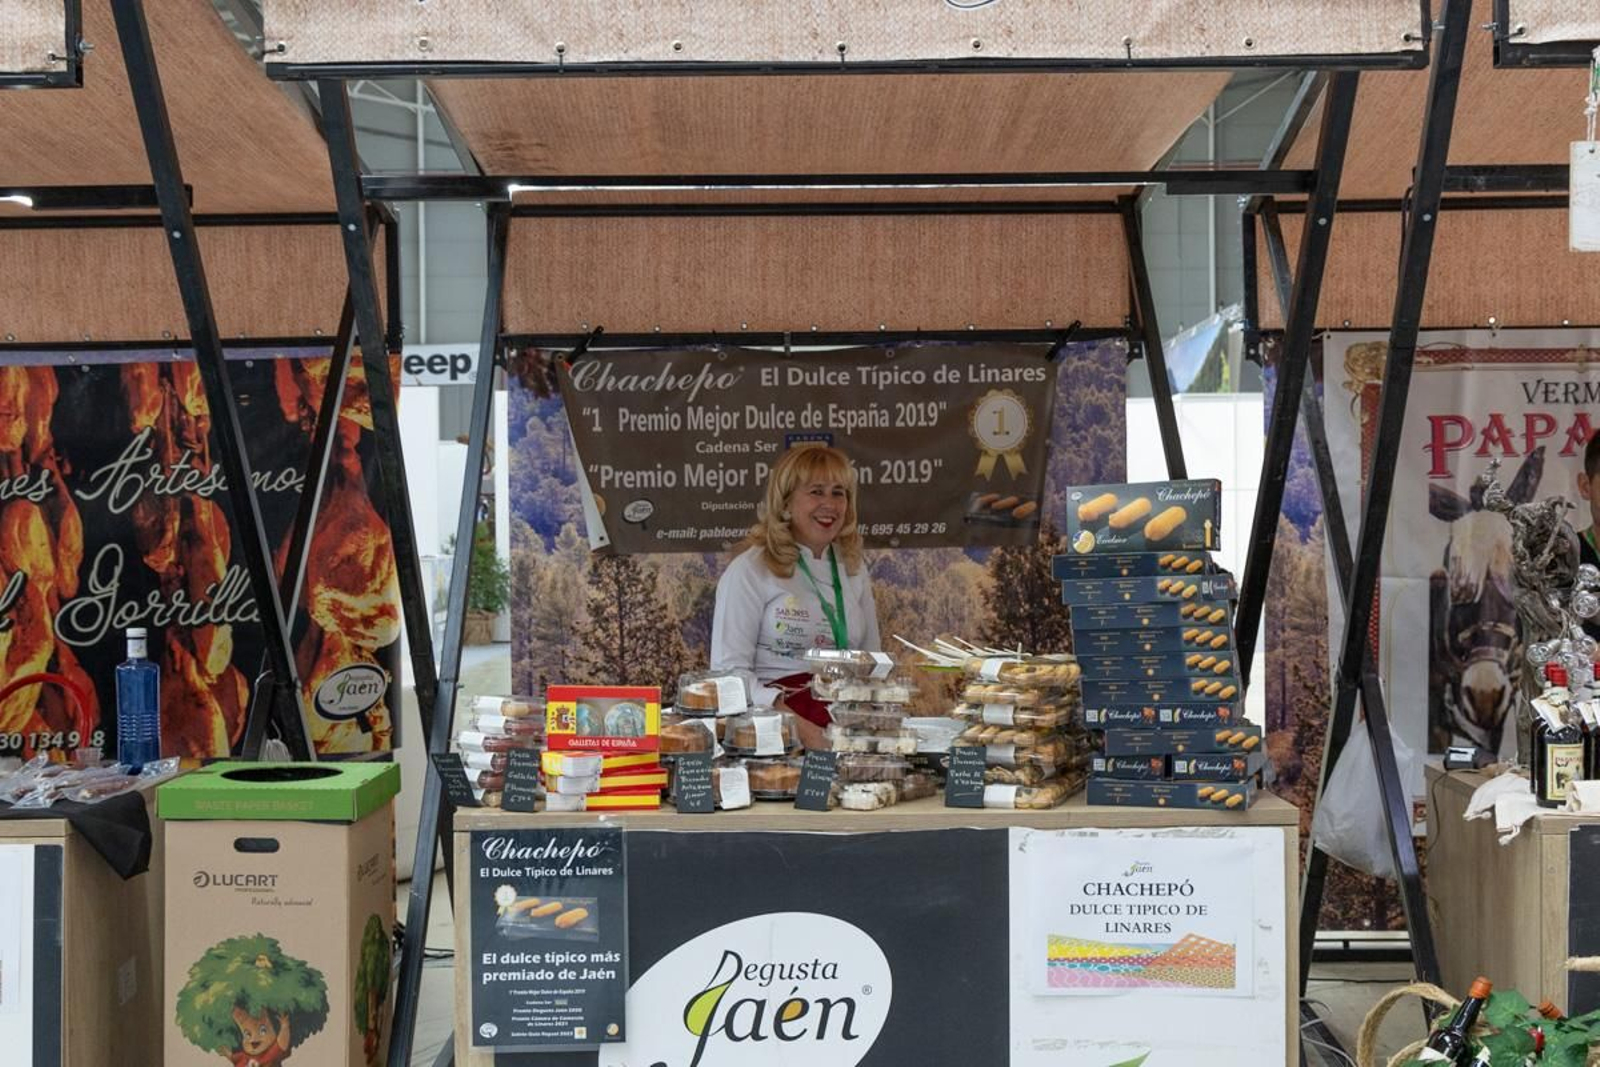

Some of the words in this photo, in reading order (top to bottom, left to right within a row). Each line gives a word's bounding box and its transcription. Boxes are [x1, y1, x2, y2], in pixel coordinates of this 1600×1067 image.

[403, 353, 472, 381] eep
[761, 367, 779, 386] El
[787, 367, 850, 386] Dulce
[857, 366, 926, 390] Típico
[933, 364, 960, 383] de
[968, 364, 1046, 383] Linares
[618, 404, 681, 432] Premio
[687, 404, 740, 437] Mejor
[745, 403, 795, 430] Dulce
[801, 403, 828, 429] de
[829, 402, 889, 435] España
[695, 441, 750, 453] Cadena
[754, 440, 779, 453] Ser
[684, 462, 748, 493] Mejor
[701, 501, 754, 512] Diputación
[871, 524, 894, 535] 695
[896, 524, 911, 534] 45
[913, 523, 929, 534] 29
[931, 522, 947, 533] 26
[29, 731, 65, 748] 134
[568, 739, 600, 747] GALLETAS
[601, 739, 610, 747] DE
[611, 738, 638, 747] ESPAÑA
[480, 868, 490, 877] El
[492, 867, 522, 877] Dulce
[525, 867, 557, 879] Típico
[560, 866, 573, 876] de
[576, 865, 613, 876] Linares
[212, 874, 278, 887] LUCART
[1083, 879, 1195, 897] CHACHEPÓ
[1069, 904, 1122, 916] DULCE
[1126, 904, 1181, 916] TIPICO
[1186, 904, 1208, 916] DE
[1105, 922, 1172, 934] LINARES
[482, 952, 497, 964] El
[500, 952, 541, 964] dulce
[545, 951, 587, 966] típico
[591, 950, 621, 963] más
[482, 969, 554, 984] premiado
[558, 969, 577, 980] de
[579, 968, 616, 980] Jaén
[706, 950, 839, 988] Degusta
[683, 986, 860, 1067] Jaén
